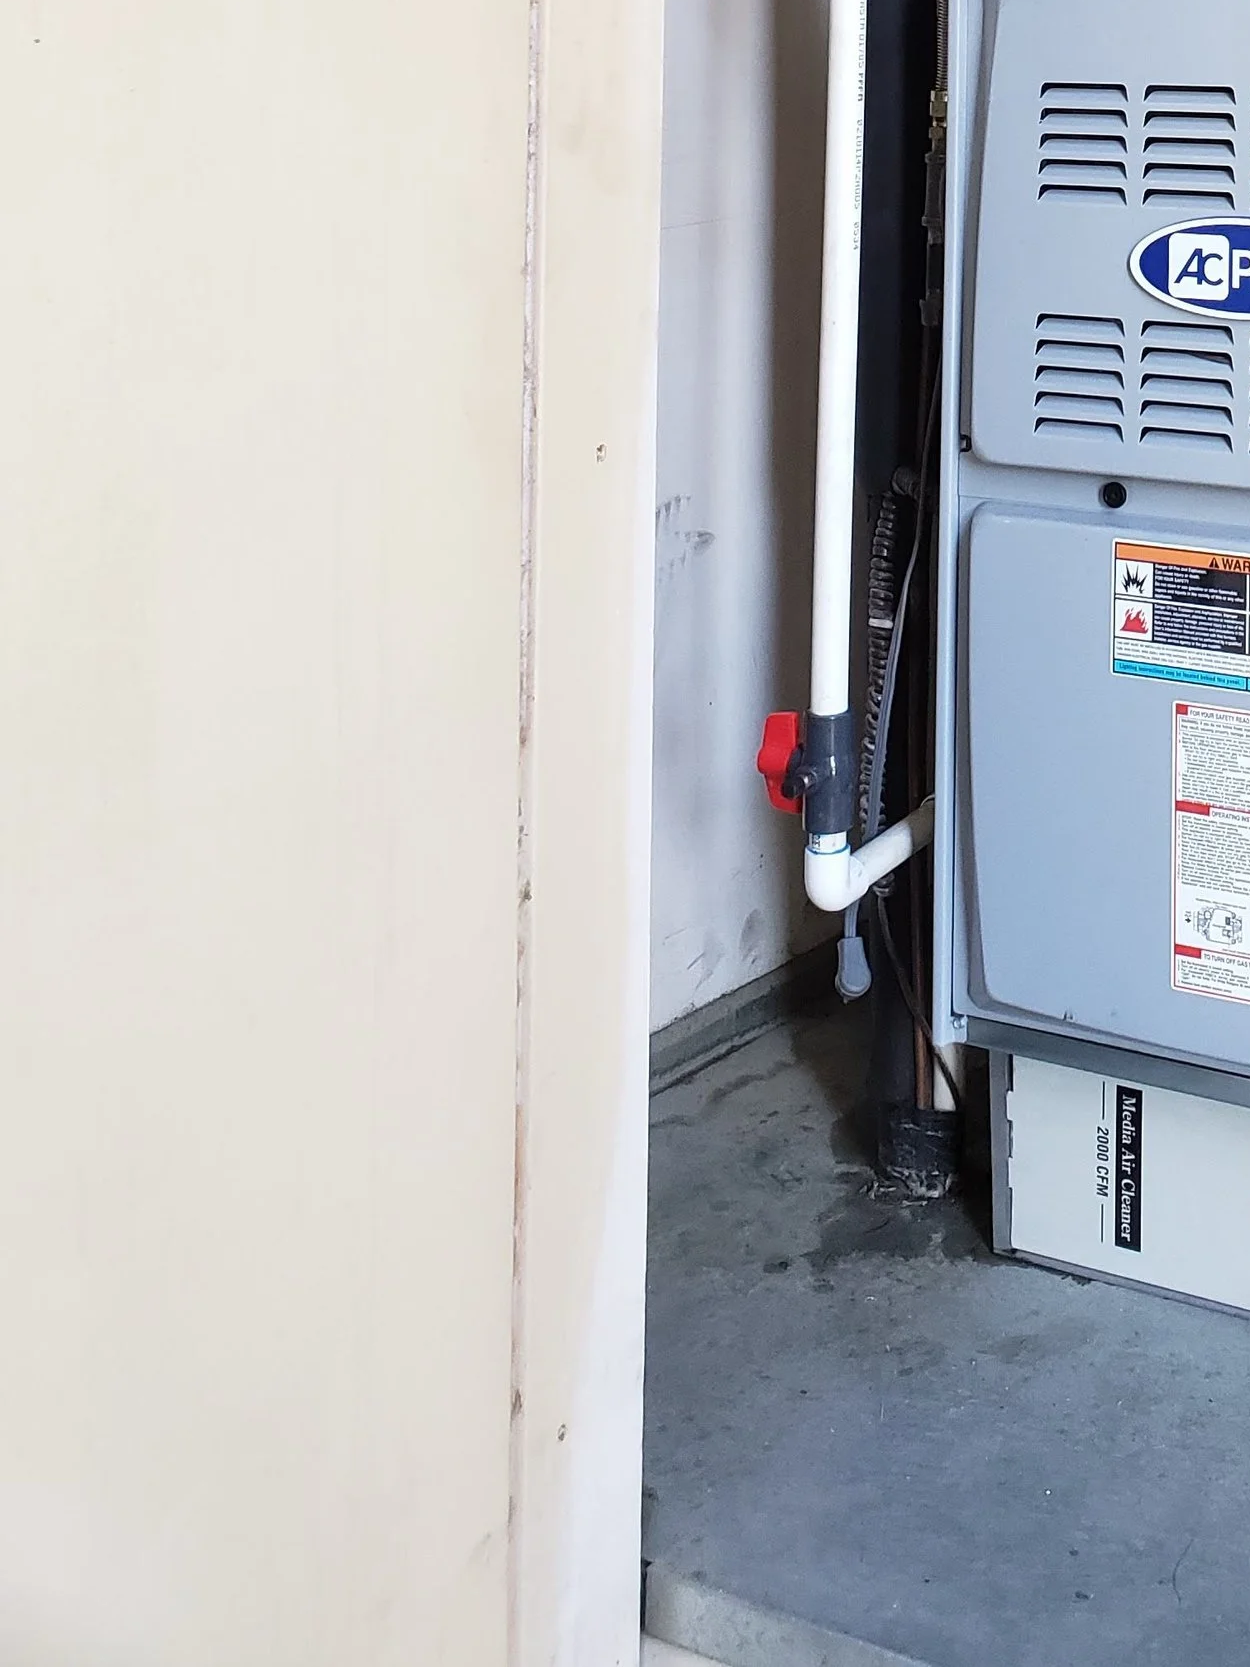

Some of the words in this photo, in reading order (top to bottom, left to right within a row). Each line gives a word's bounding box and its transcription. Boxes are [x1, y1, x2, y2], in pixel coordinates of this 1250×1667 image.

[1174, 248, 1223, 285] AC
[1190, 709, 1201, 718] FOR
[1201, 711, 1215, 720] YOUR
[1215, 713, 1235, 722] SAFETY
[1235, 715, 1250, 725] READ
[1211, 810, 1240, 822] OPERATING
[1211, 954, 1225, 963] TURN
[1226, 957, 1236, 965] OFF
[1236, 959, 1248, 968] GAS
[1122, 1094, 1136, 1144] Media
[1097, 1126, 1109, 1162] 2000
[1122, 1147, 1136, 1175] Air
[1096, 1165, 1109, 1198] CFM
[1120, 1178, 1136, 1242] Cleaner
